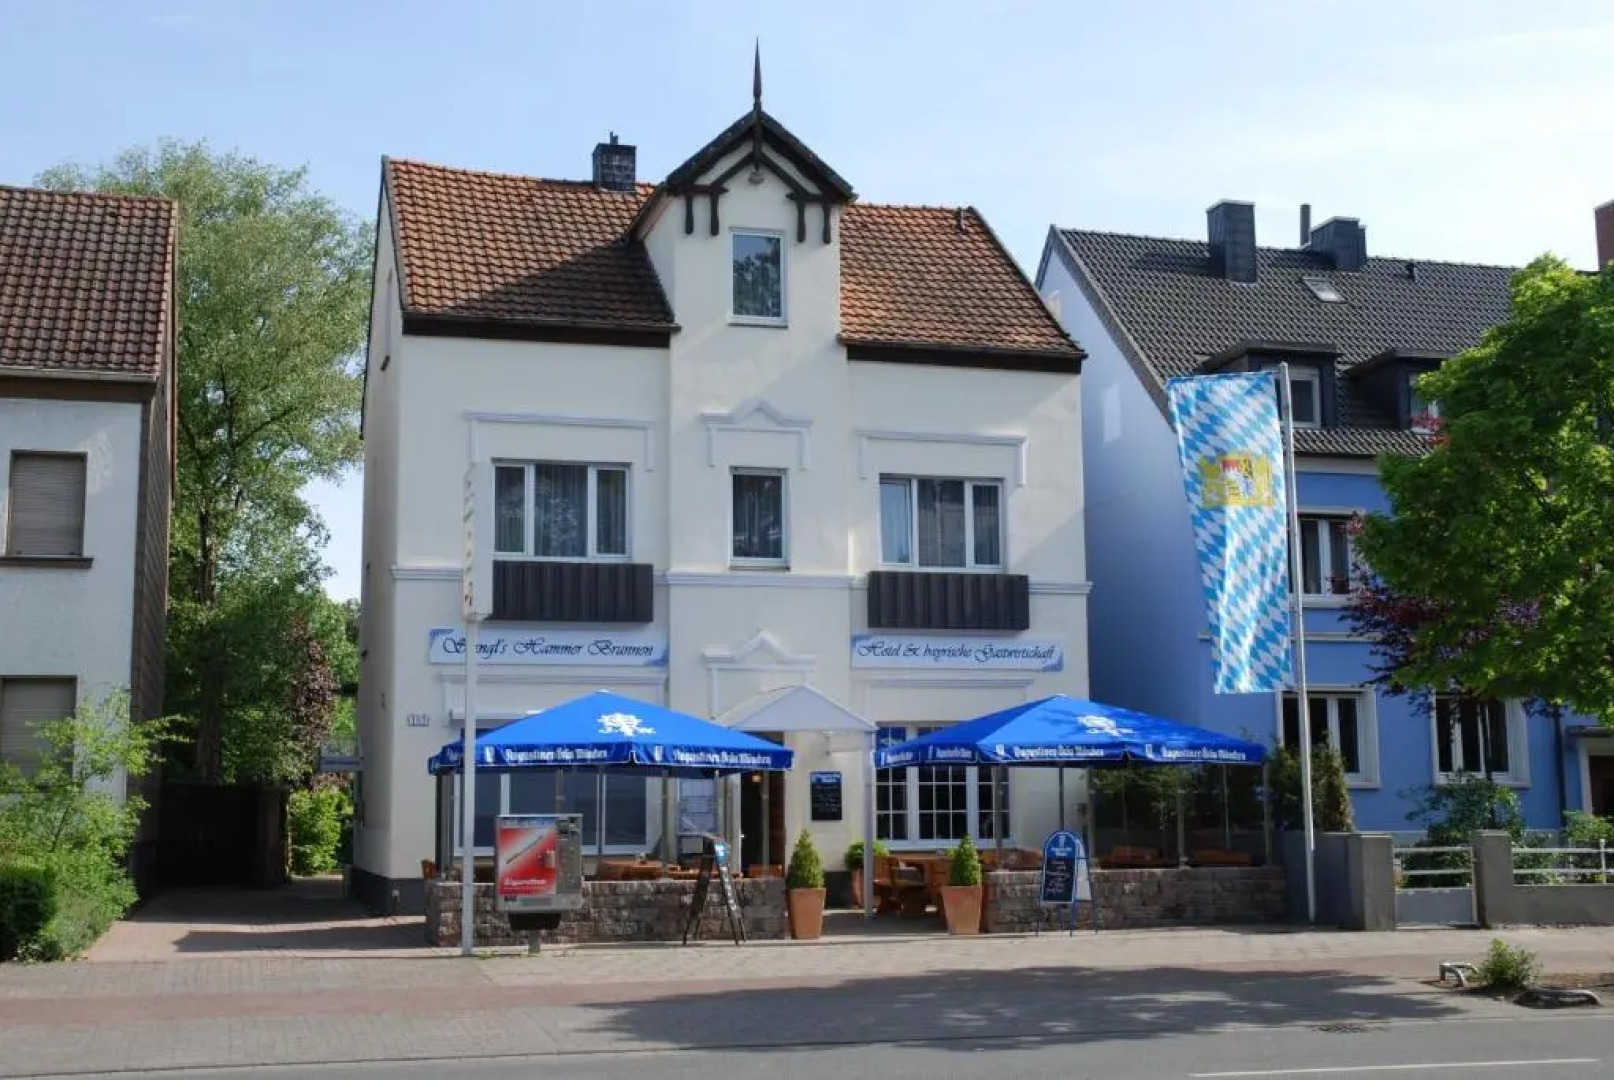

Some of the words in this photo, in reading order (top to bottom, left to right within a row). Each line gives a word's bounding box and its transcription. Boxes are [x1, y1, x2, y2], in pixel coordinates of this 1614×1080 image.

[514, 637, 583, 655] Hammer
[588, 639, 653, 656] Brunnen
[858, 641, 902, 657] Hotel
